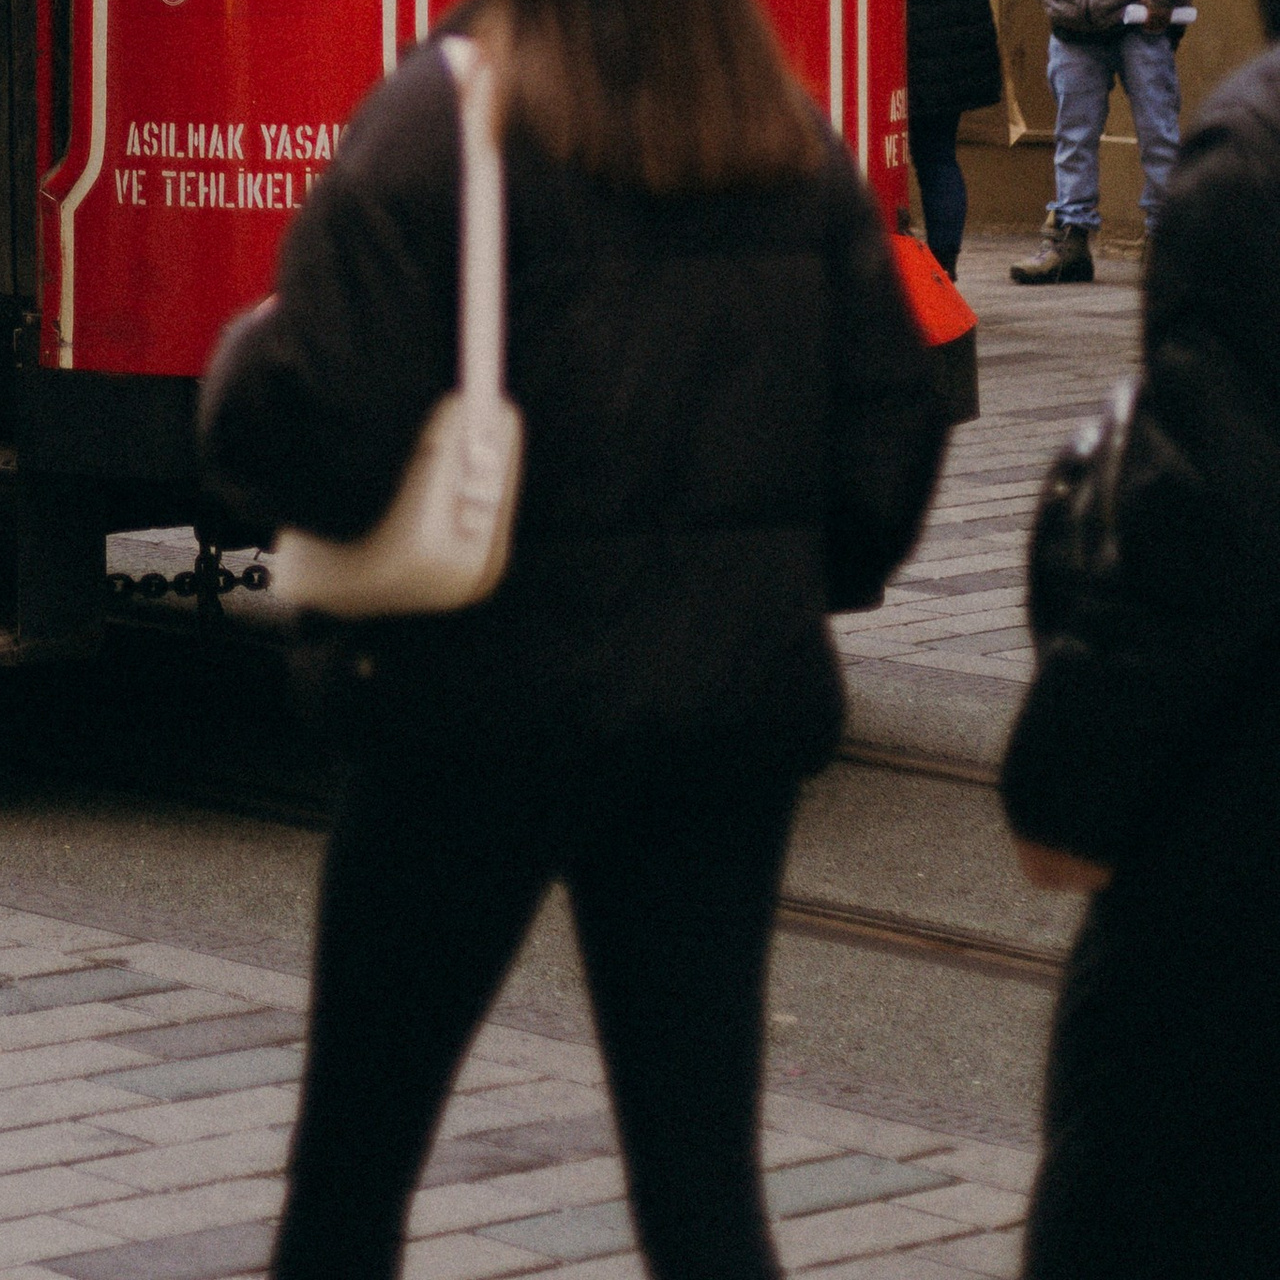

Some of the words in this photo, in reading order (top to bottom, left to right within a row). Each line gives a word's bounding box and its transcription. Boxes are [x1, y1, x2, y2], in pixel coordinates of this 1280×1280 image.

[125, 121, 245, 161] ASILMAK
[114, 168, 147, 206] VE
[161, 167, 322, 210] TEHLİKELİ
